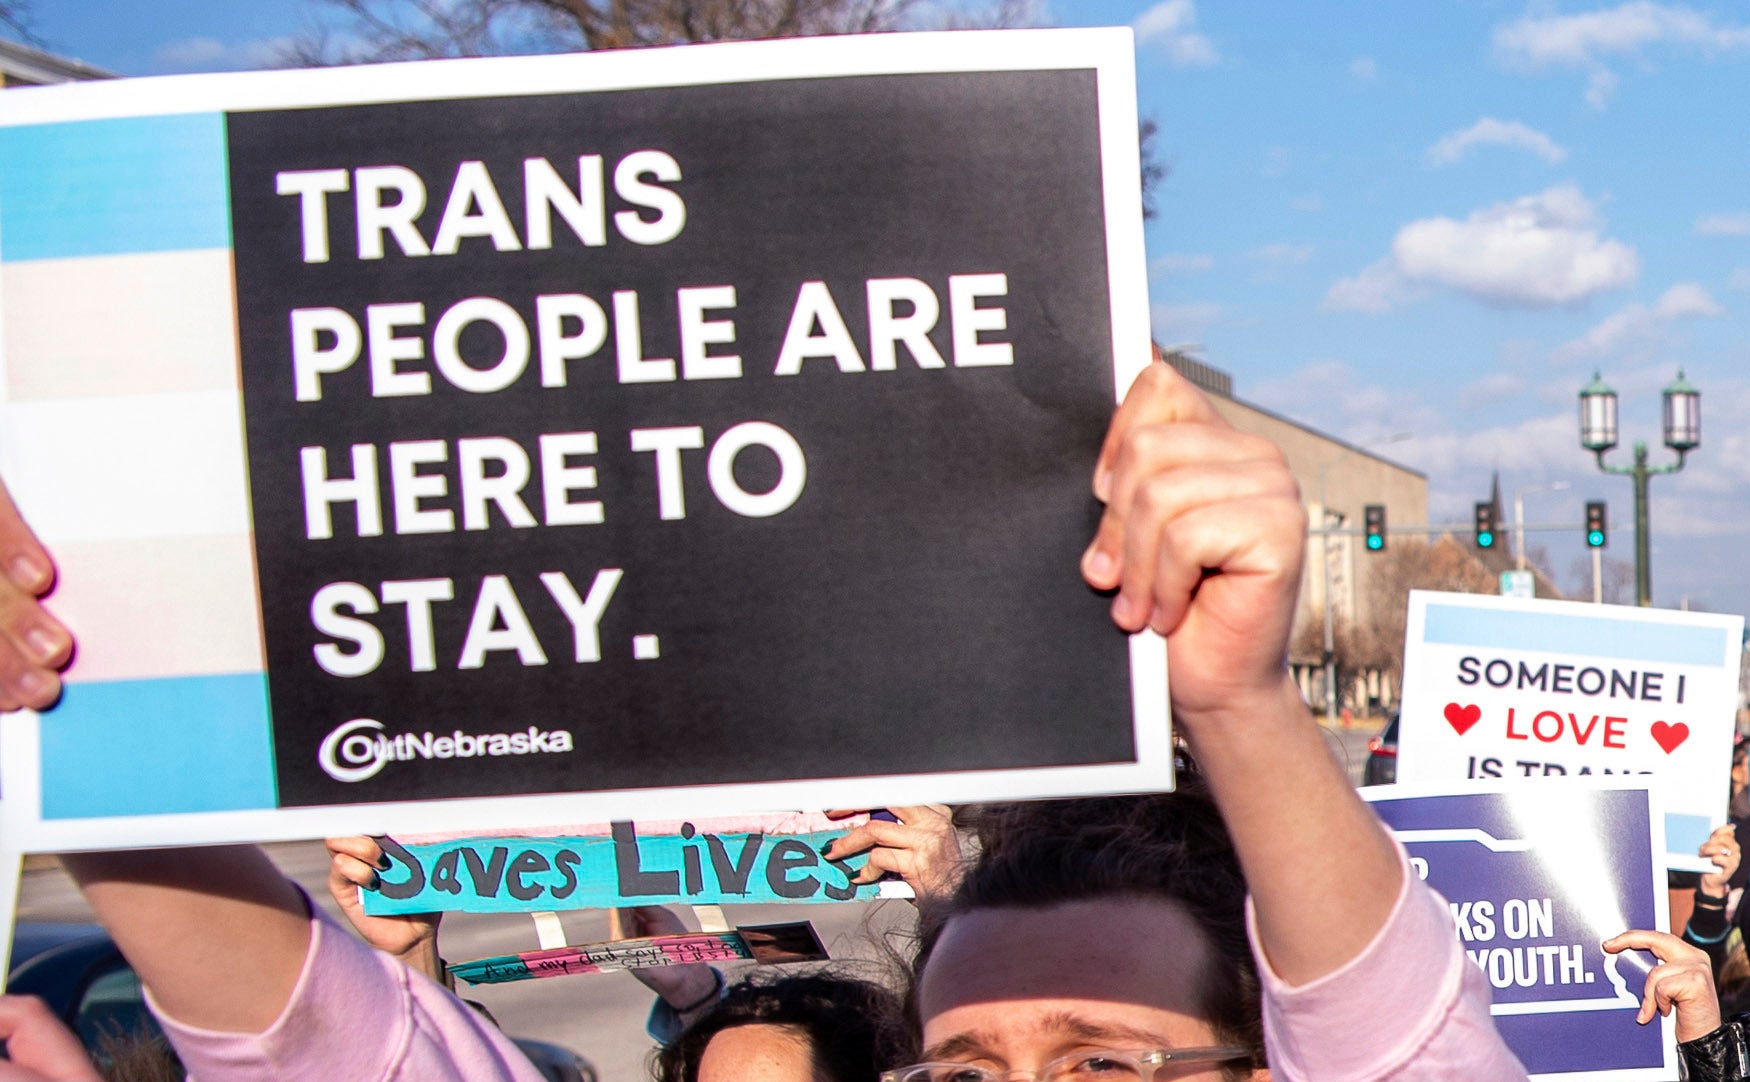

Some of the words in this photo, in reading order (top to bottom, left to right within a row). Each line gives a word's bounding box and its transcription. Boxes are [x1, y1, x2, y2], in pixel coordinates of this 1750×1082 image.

[275, 150, 687, 264] TRANS
[289, 284, 743, 402] PEOPLE
[774, 272, 1016, 376] ARE
[298, 431, 605, 541] HERE
[630, 421, 809, 522] TO
[309, 567, 662, 678] STAY.
[1457, 656, 1663, 702] SOMEONE
[1676, 674, 1686, 704] I
[1505, 707, 1628, 749] LOVE
[1503, 898, 1553, 940] ON
[538, 960, 569, 976] my
[578, 946, 617, 966] dad
